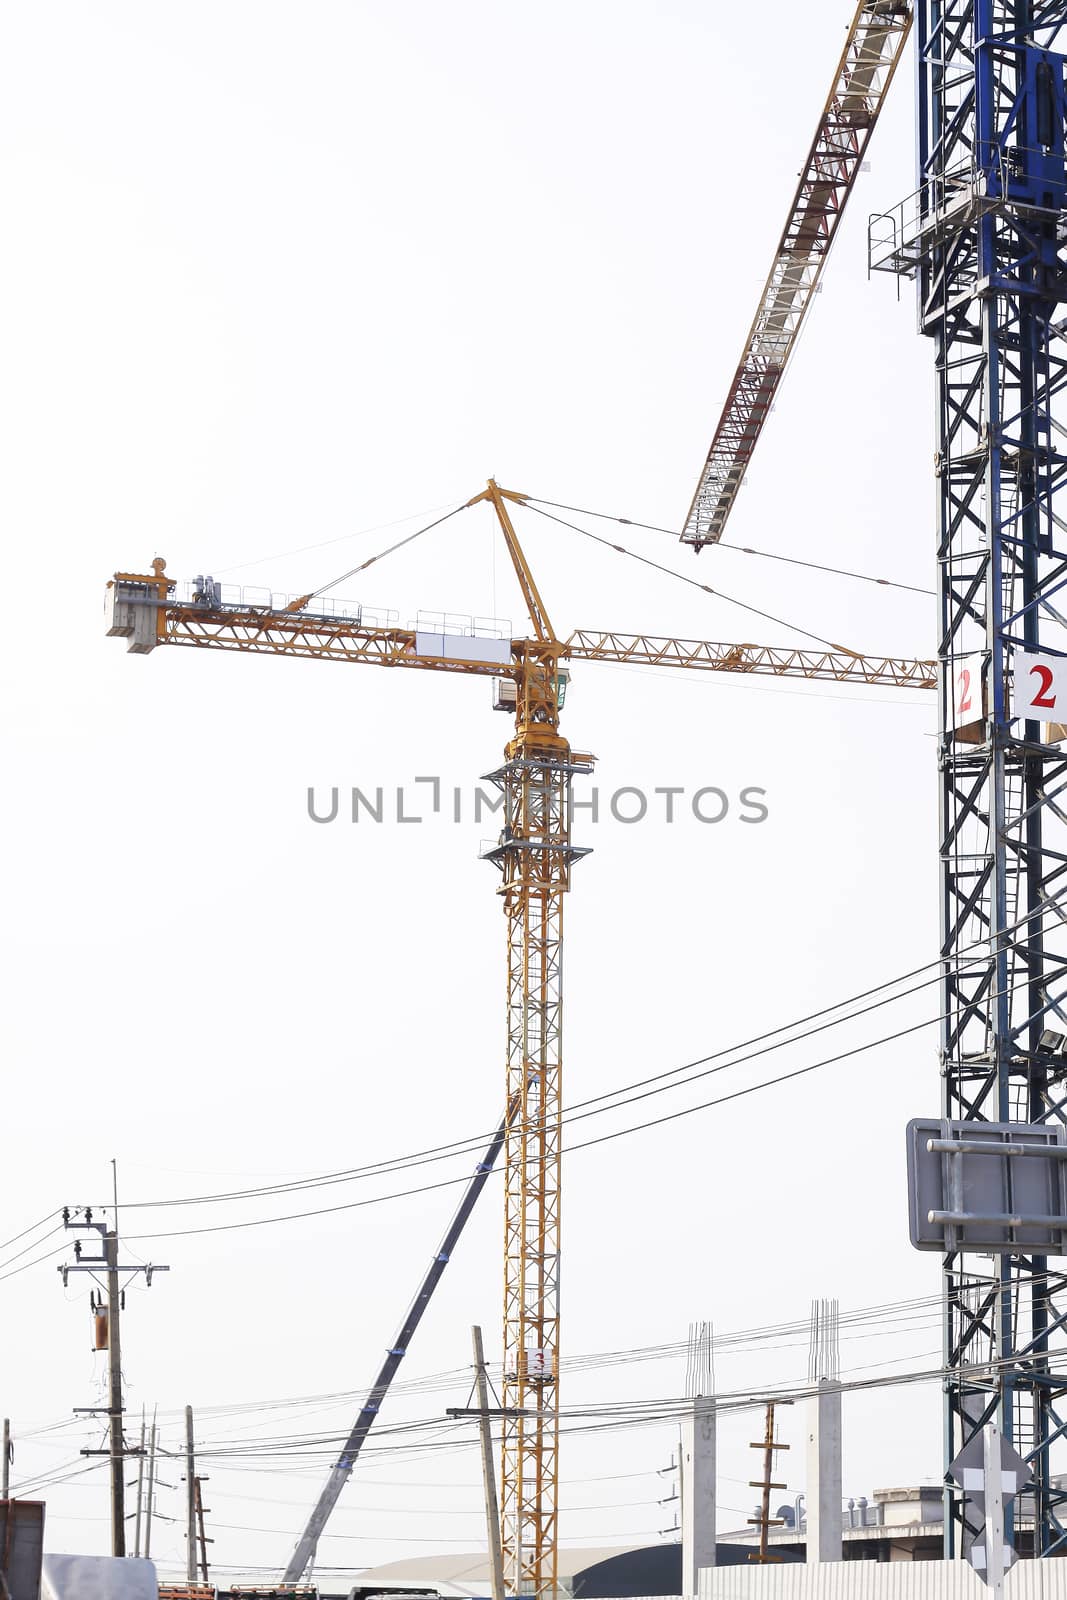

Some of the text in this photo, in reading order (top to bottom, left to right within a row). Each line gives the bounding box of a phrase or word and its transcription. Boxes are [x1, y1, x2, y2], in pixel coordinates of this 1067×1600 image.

[957, 669, 971, 714] 2
[1029, 664, 1056, 708] 2
[534, 1352, 545, 1370] 3
